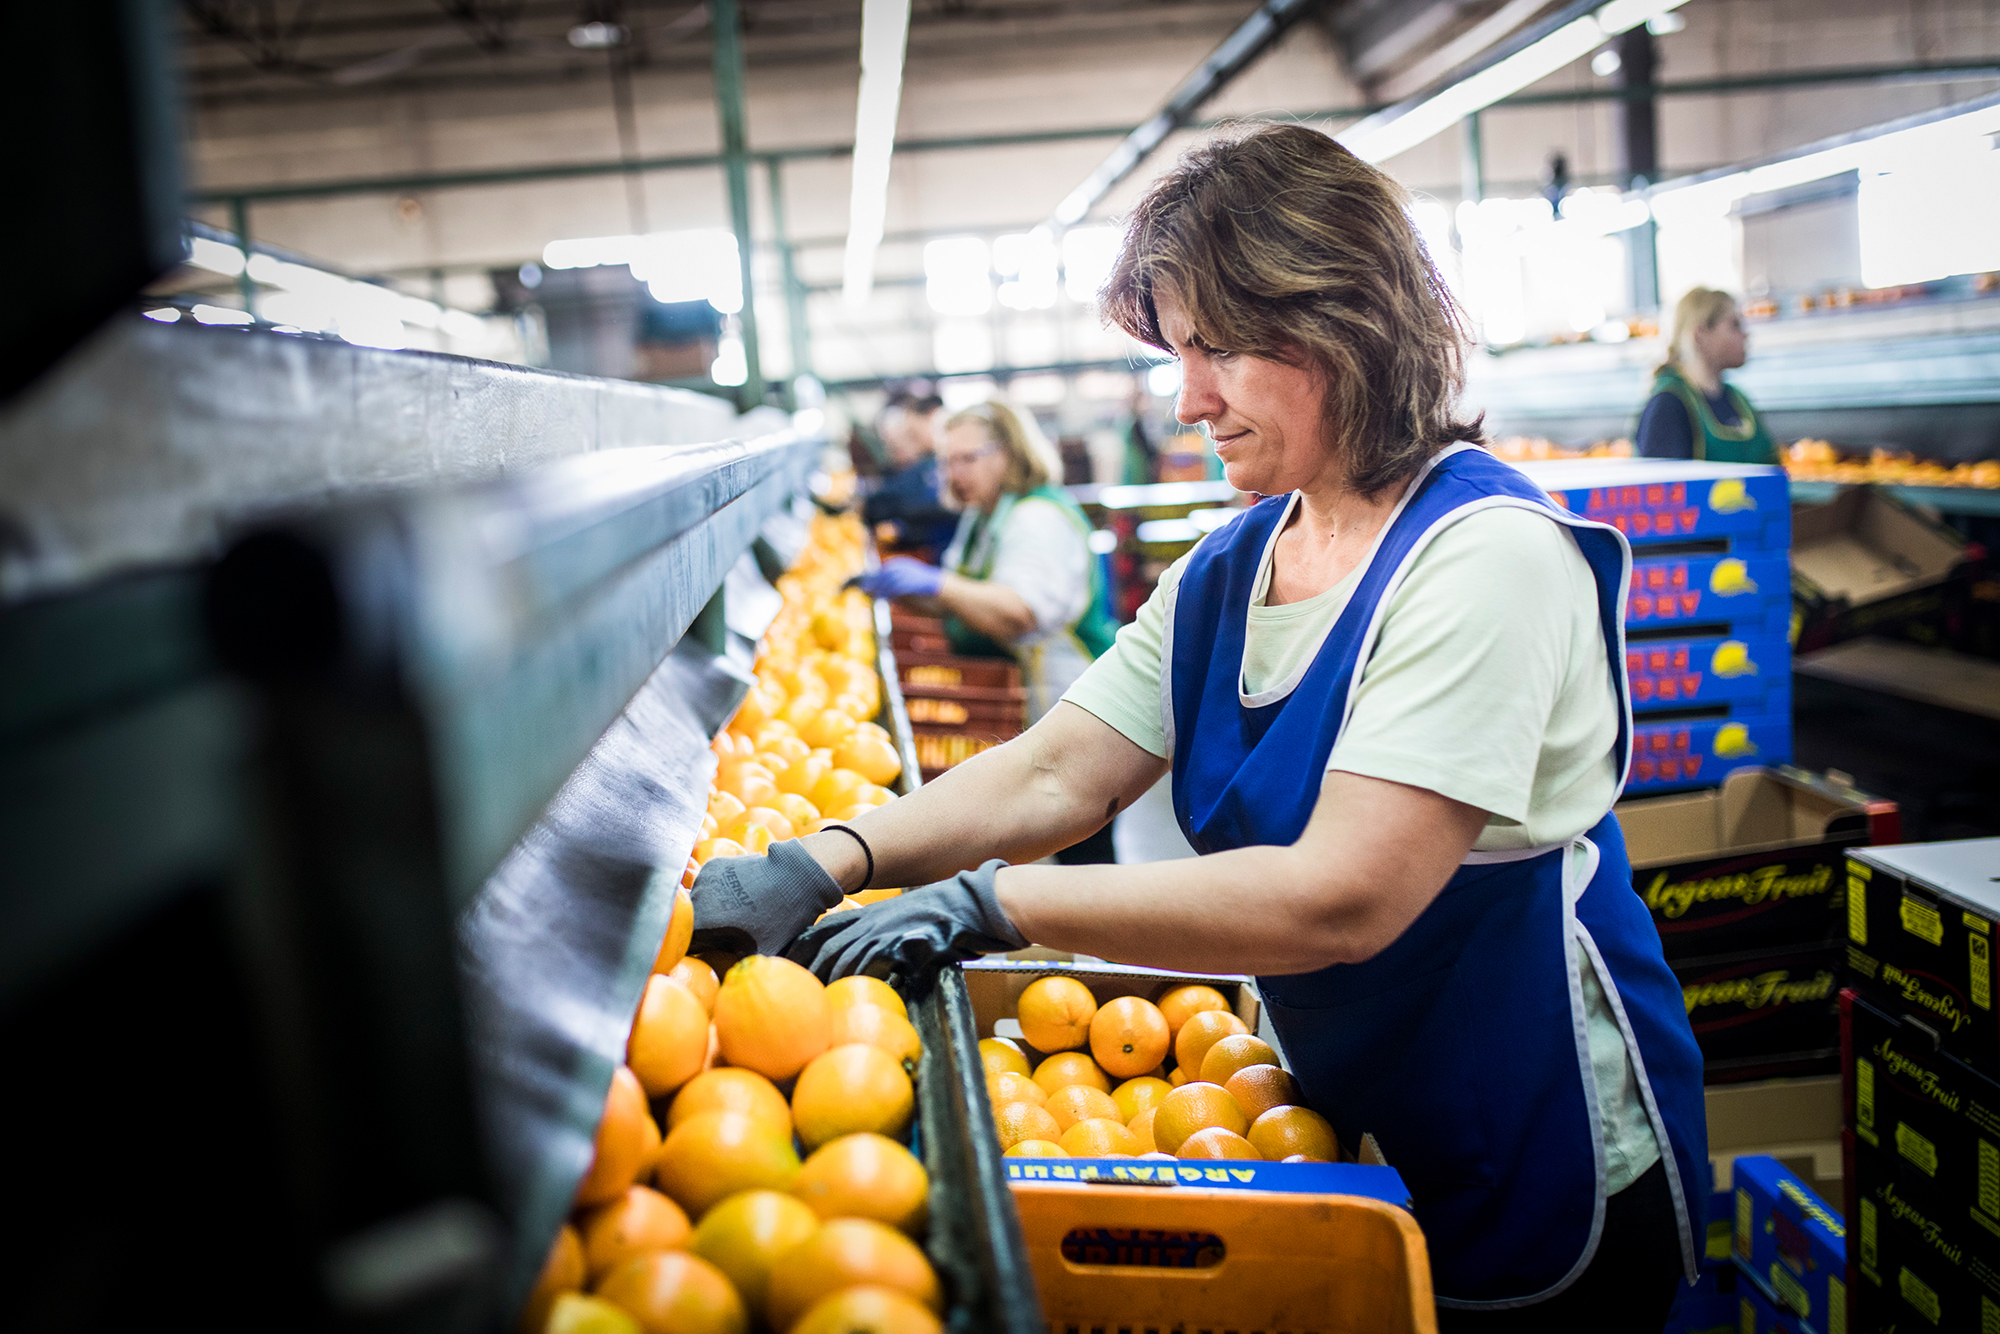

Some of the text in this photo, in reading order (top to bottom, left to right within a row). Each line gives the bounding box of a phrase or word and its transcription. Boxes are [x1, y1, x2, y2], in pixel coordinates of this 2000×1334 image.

[1590, 508, 1699, 534] ARGE
[1743, 863, 1836, 905] Fruit
[1683, 969, 1837, 1015] geas Fruit
[1917, 989, 1972, 1033] Argeas
[1872, 1037, 1925, 1083] Argeas
[1920, 1070, 1960, 1113] Fruit
[1008, 1164, 1257, 1183] ARGEAS FRUI
[1875, 1182, 1927, 1230] Argeas
[1923, 1220, 1963, 1266] Fruit
